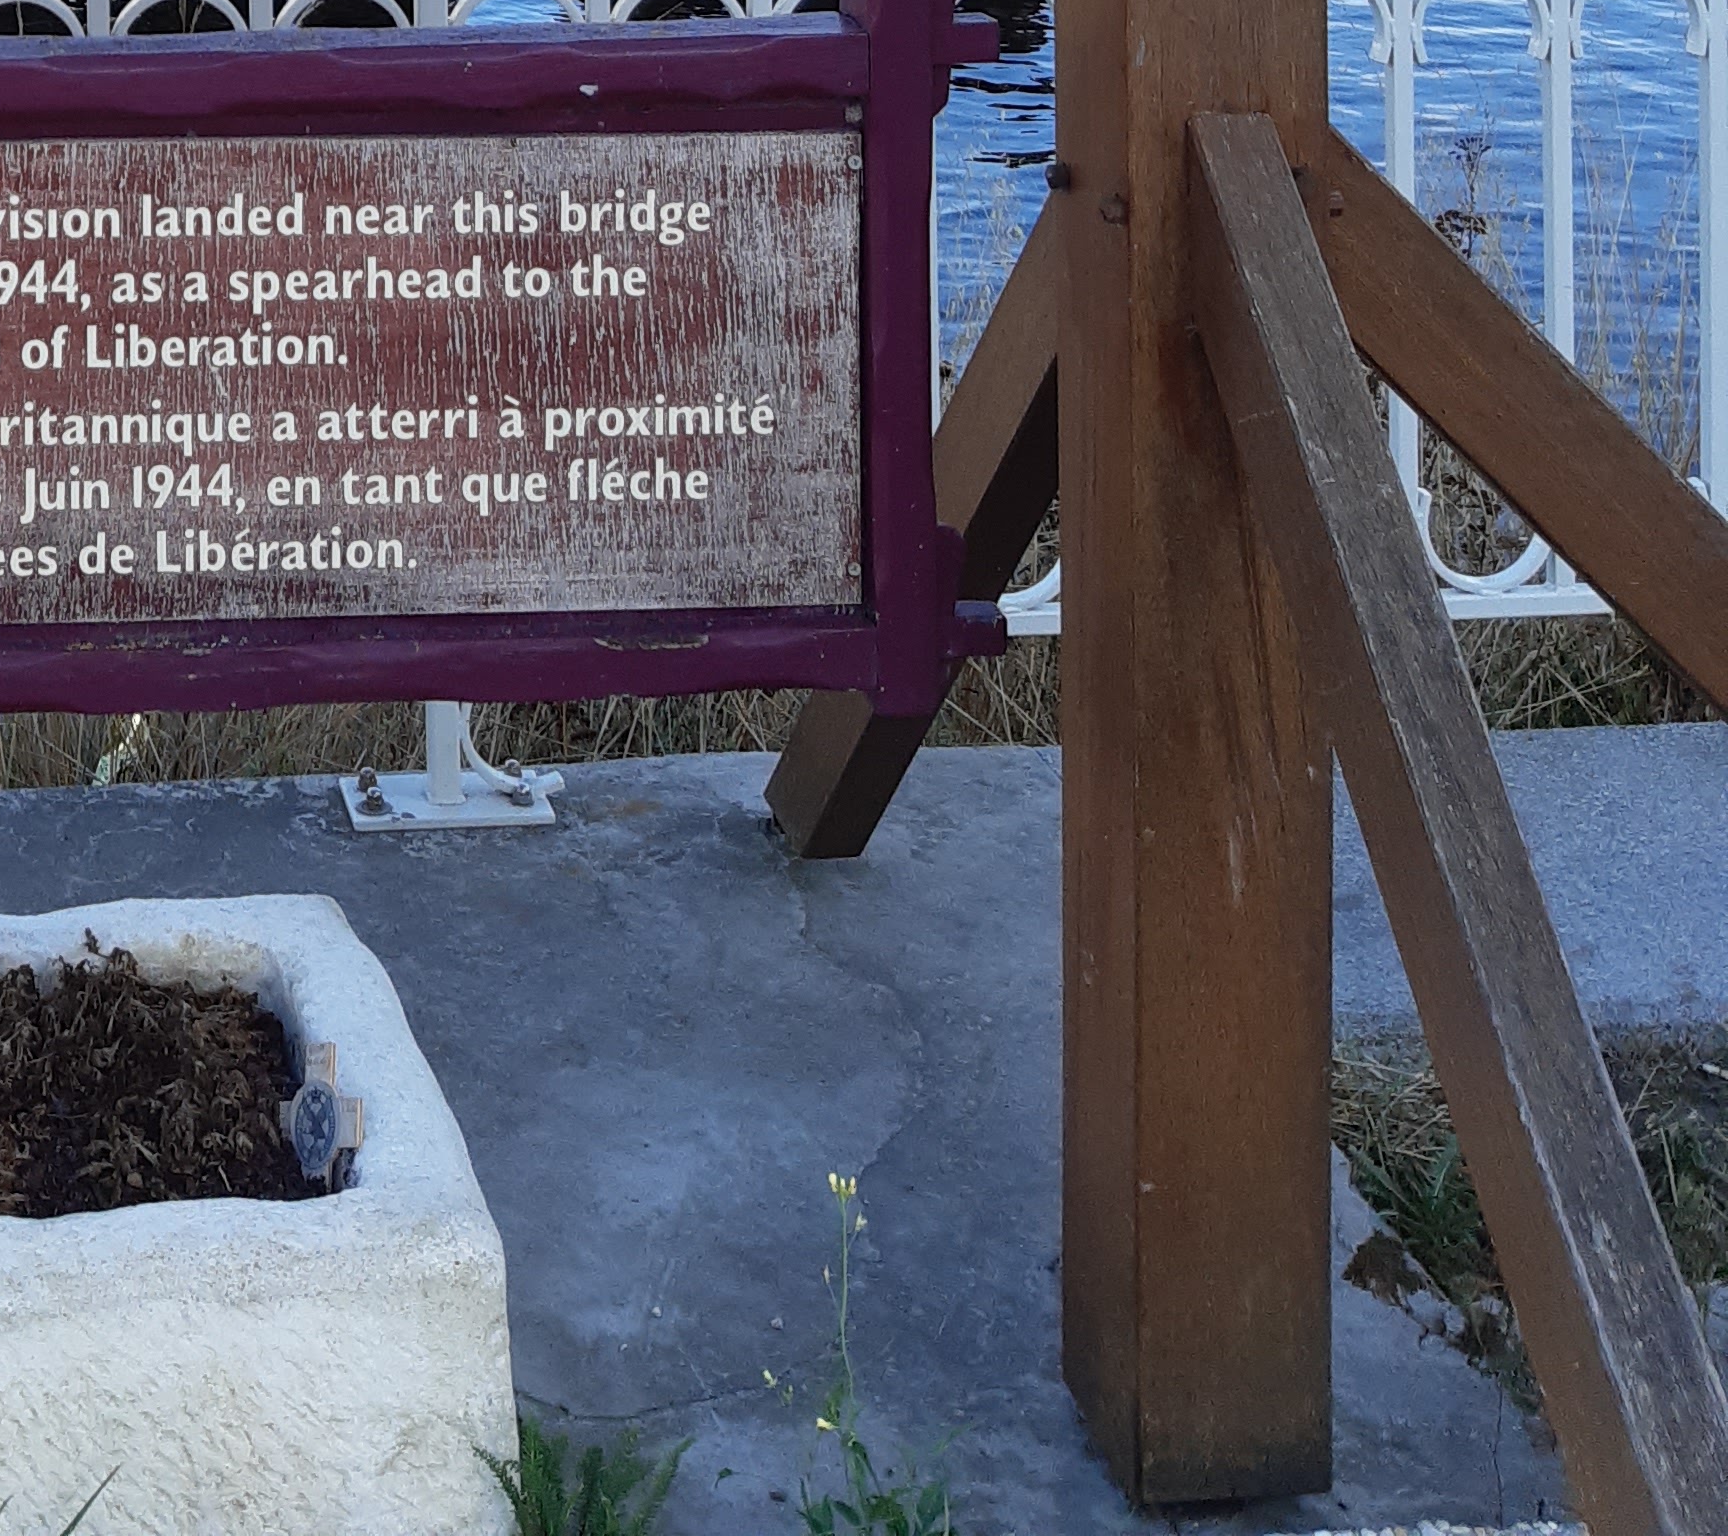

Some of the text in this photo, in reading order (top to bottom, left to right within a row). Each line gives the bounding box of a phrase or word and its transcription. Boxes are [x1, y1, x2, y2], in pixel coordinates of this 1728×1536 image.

[141, 191, 304, 238] landed
[324, 203, 435, 236] near
[452, 188, 539, 235] this
[559, 187, 712, 247] bridge
[111, 271, 163, 304] as
[182, 270, 210, 303] a
[228, 254, 483, 316] spearhead
[502, 261, 552, 299] to
[569, 253, 648, 298] the
[20, 324, 70, 370] of
[85, 320, 349, 369] Liberation.
[271, 410, 299, 443] a
[316, 394, 479, 442] atterri
[498, 394, 526, 439] à
[544, 392, 775, 452] proximité
[19, 464, 111, 525] Juin
[132, 462, 247, 515] 1944,
[266, 475, 322, 507] en
[340, 466, 444, 506] tant
[461, 471, 548, 518] que
[77, 531, 135, 576] de
[155, 525, 418, 574] Libération.
